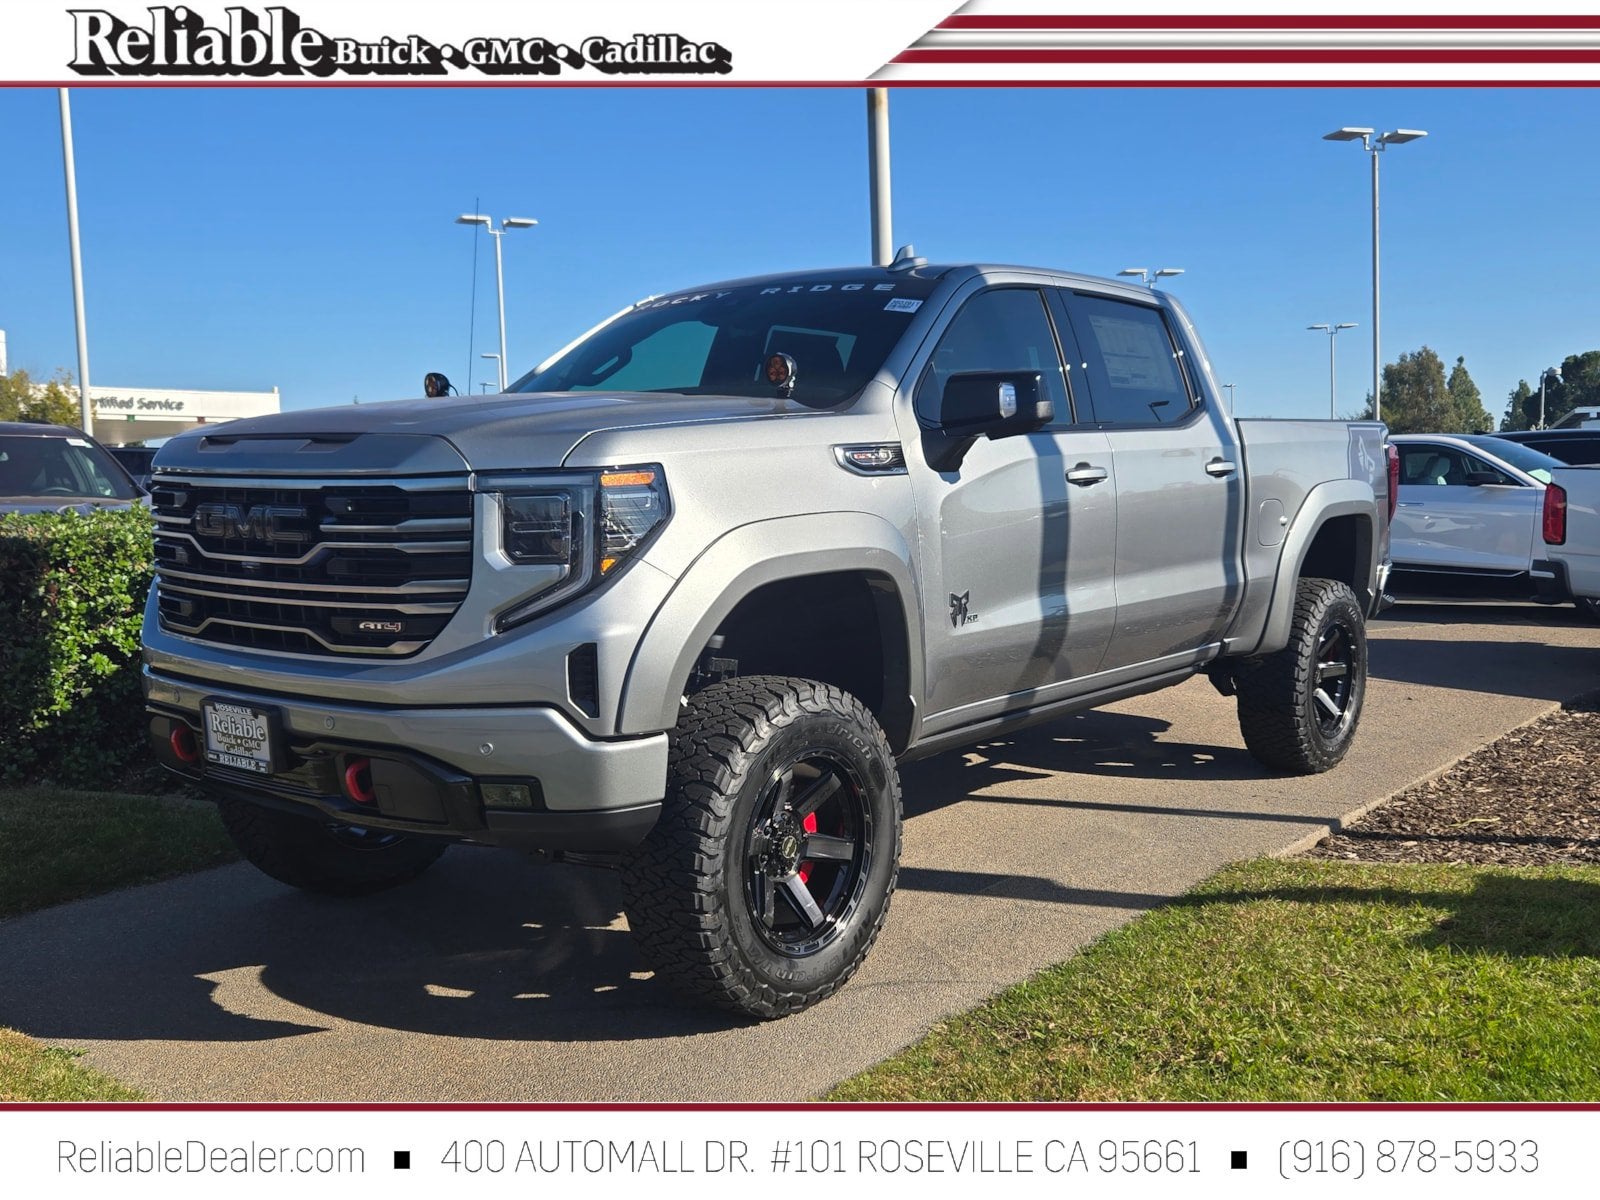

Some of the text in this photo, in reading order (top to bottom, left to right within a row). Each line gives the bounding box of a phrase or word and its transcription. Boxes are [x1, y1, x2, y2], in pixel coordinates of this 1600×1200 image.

[759, 283, 897, 296] RIDGE
[137, 398, 184, 411] Service
[195, 503, 308, 542] GMC
[359, 621, 402, 633] AT4
[210, 712, 266, 741] Reliable
[217, 732, 262, 751] Buick GMC
[224, 743, 254, 758] Cadillac
[219, 753, 257, 770] RELIABLE
